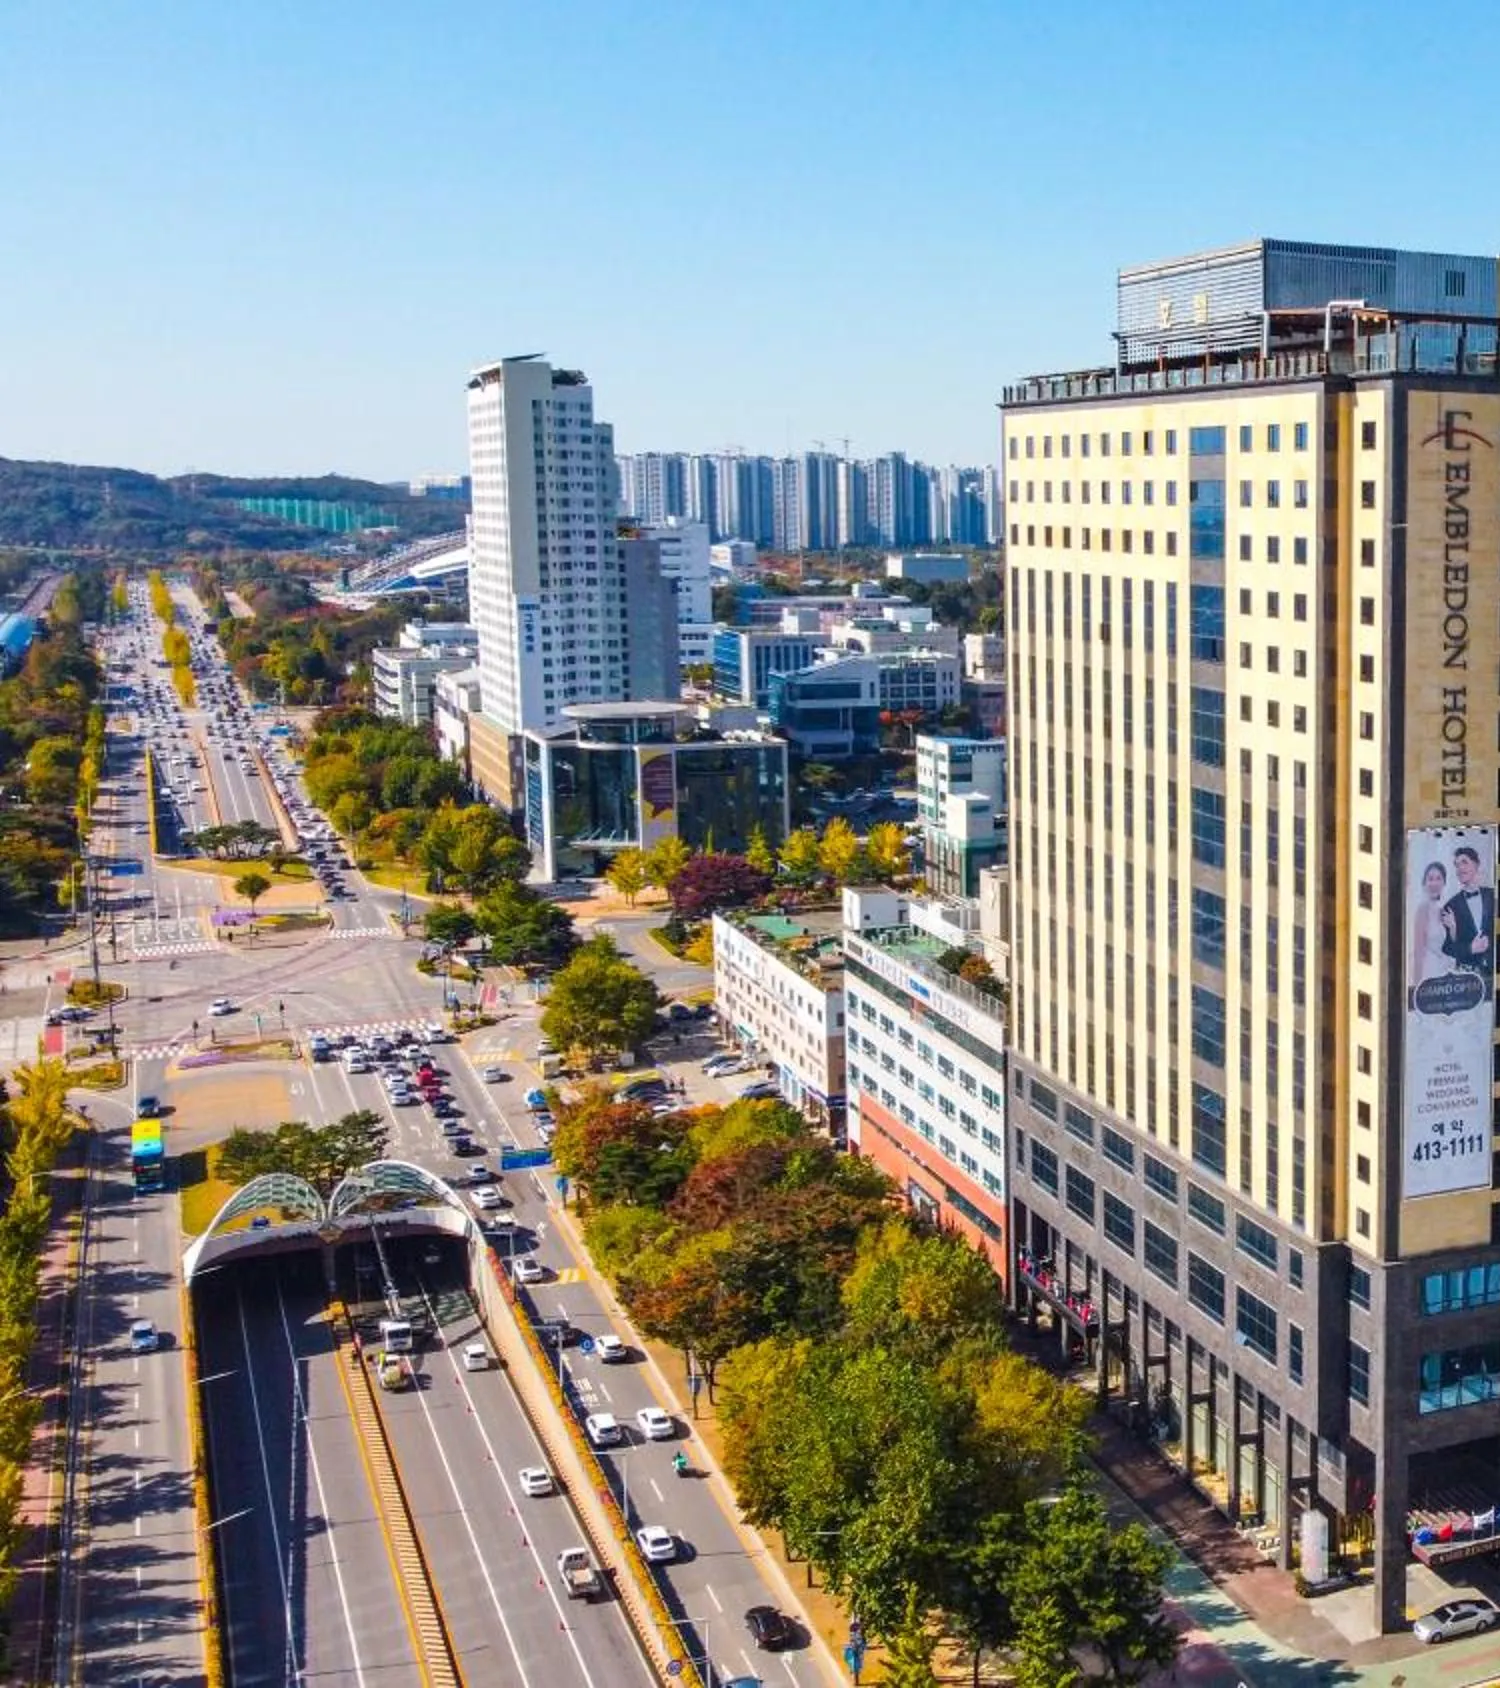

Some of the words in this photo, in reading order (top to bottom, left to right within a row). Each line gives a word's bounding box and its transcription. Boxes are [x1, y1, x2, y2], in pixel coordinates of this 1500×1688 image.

[1443, 461, 1471, 670] EMBLEDON
[1441, 686, 1467, 808] HOTEL
[1413, 1133, 1483, 1161] 413-1111
